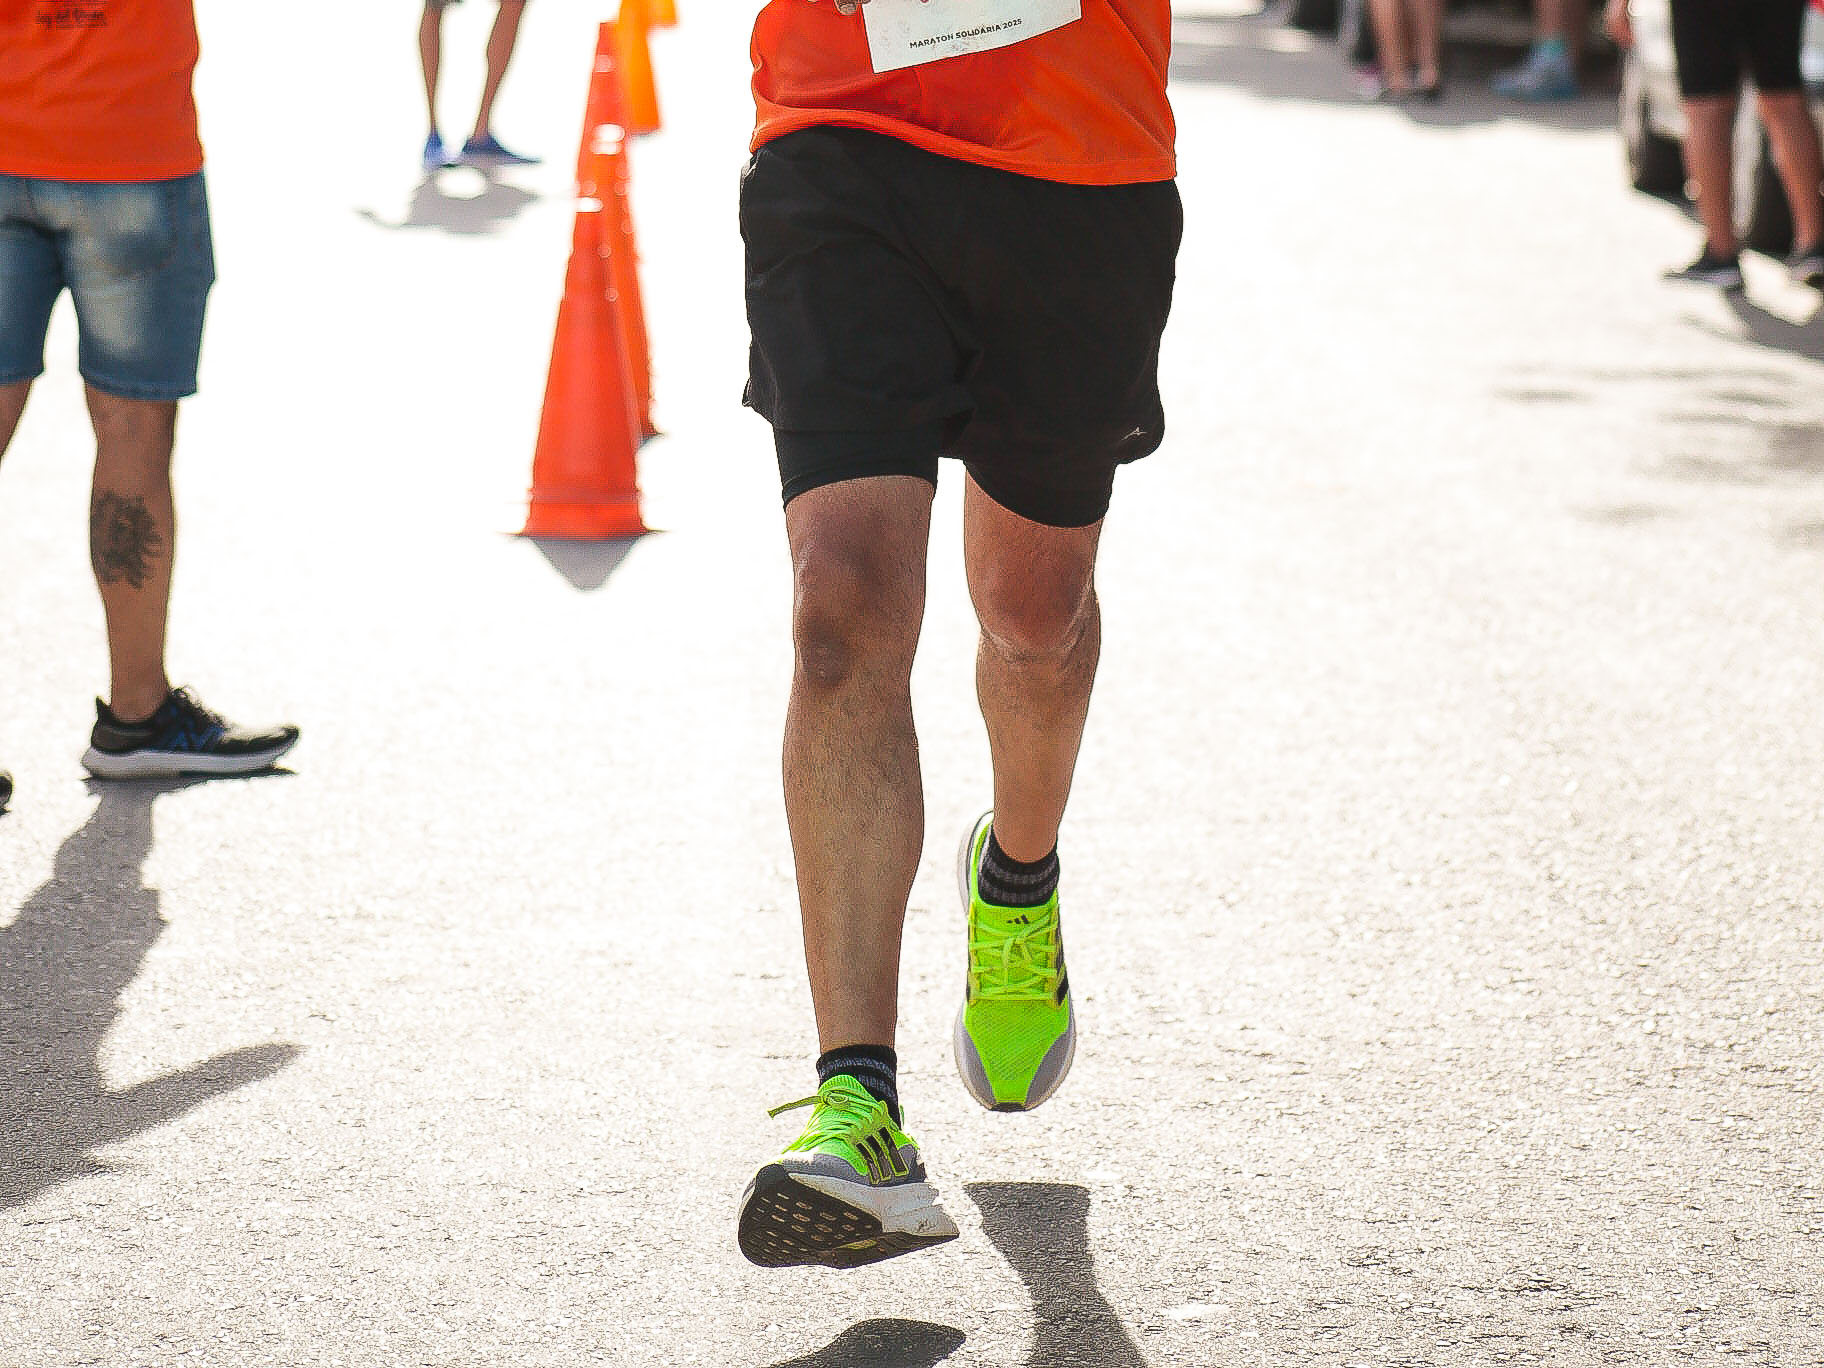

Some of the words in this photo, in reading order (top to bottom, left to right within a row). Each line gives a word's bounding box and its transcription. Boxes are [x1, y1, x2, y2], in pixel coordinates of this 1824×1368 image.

[909, 32, 954, 49] MARATON
[955, 24, 1001, 40] SOLIDARIA
[1002, 18, 1023, 30] 2025
